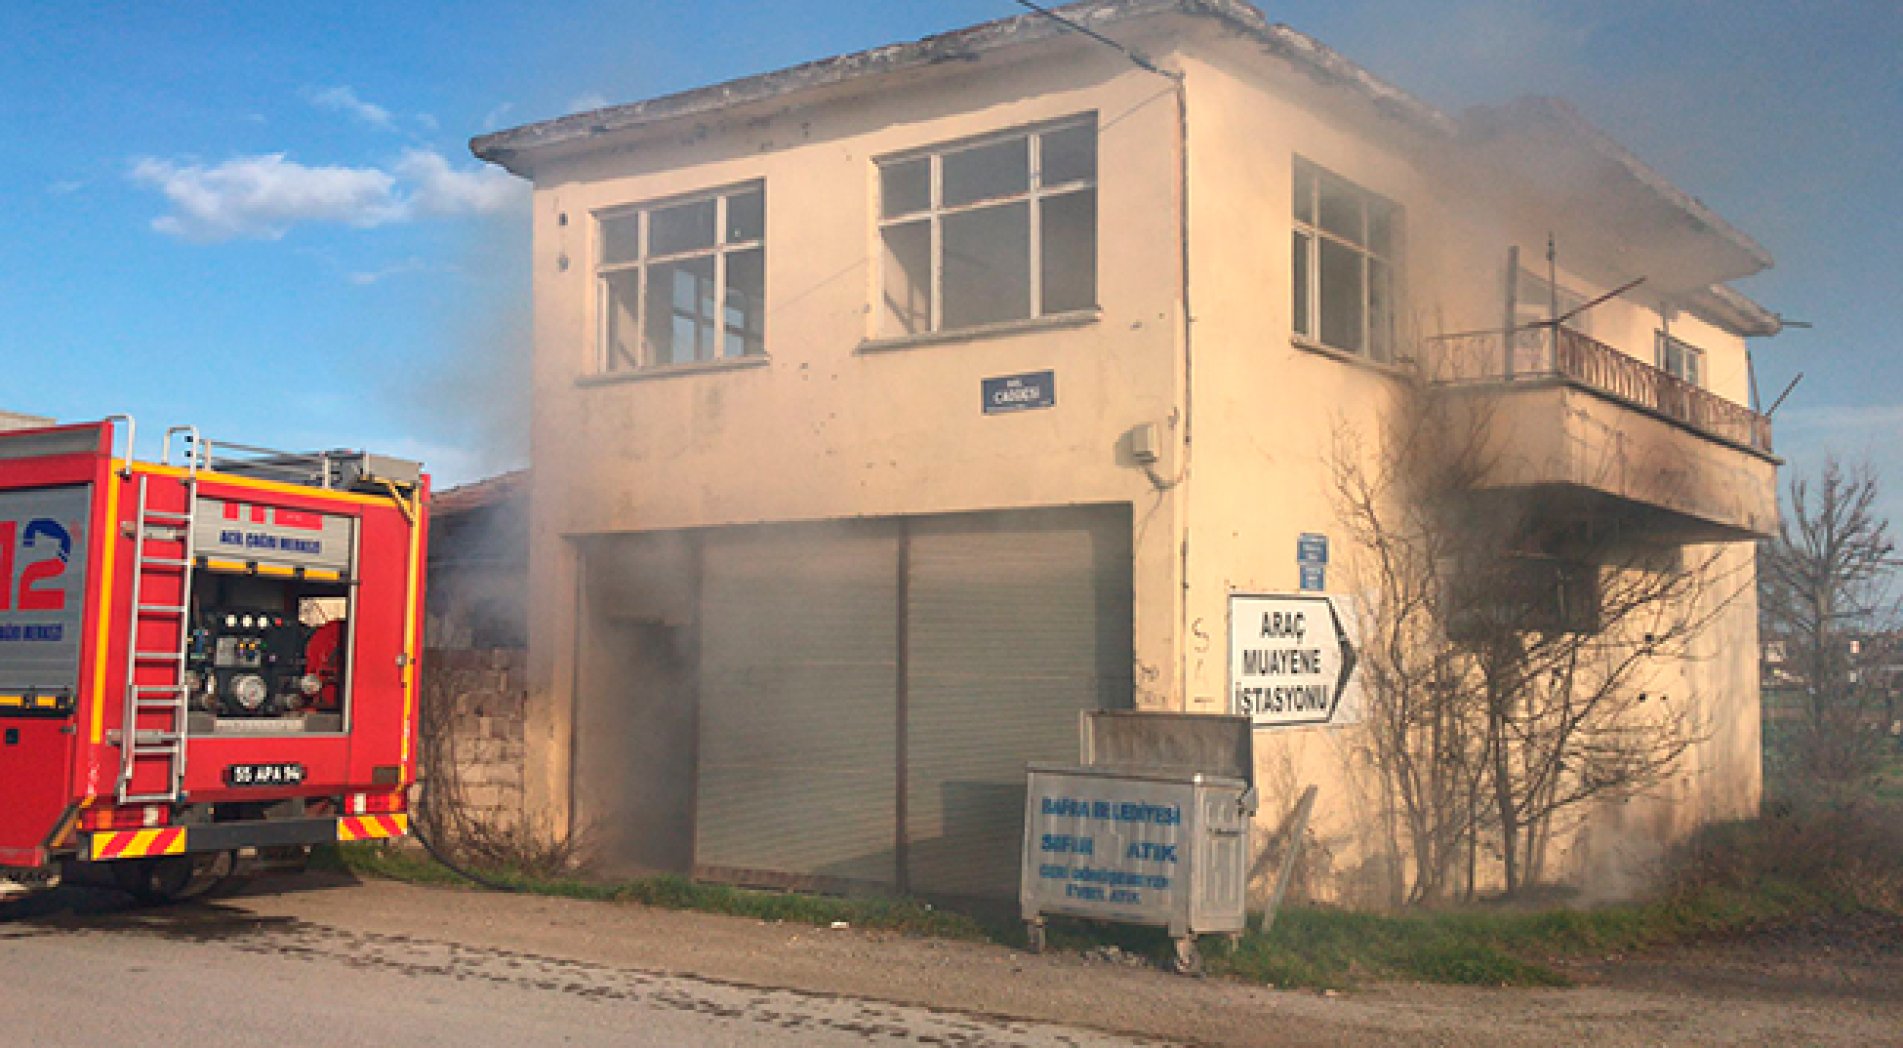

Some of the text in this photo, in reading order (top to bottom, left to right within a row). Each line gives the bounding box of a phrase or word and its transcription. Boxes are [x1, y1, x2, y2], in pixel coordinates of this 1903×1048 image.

[1260, 611, 1307, 644] ARAÇ
[1242, 649, 1322, 677] MUAYENE
[1235, 681, 1328, 715] İSTASYONU
